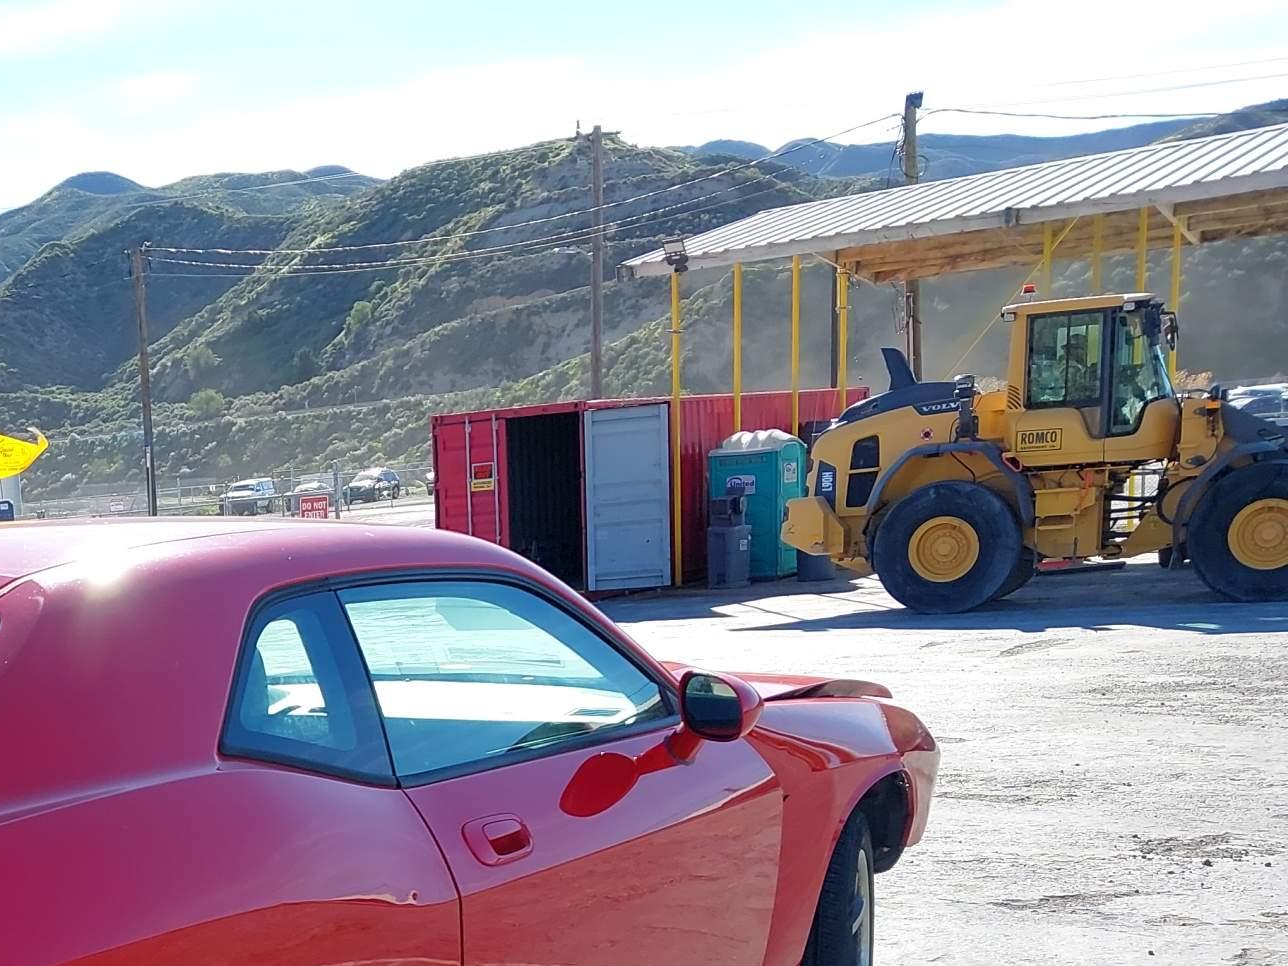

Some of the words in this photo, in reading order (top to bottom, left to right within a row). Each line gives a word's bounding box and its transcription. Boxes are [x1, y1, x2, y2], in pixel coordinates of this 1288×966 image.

[921, 401, 960, 411] VOLV
[1021, 431, 1058, 445] ROMCO
[821, 471, 833, 491] L90H
[302, 502, 312, 510] DO
[313, 501, 326, 510] NOT
